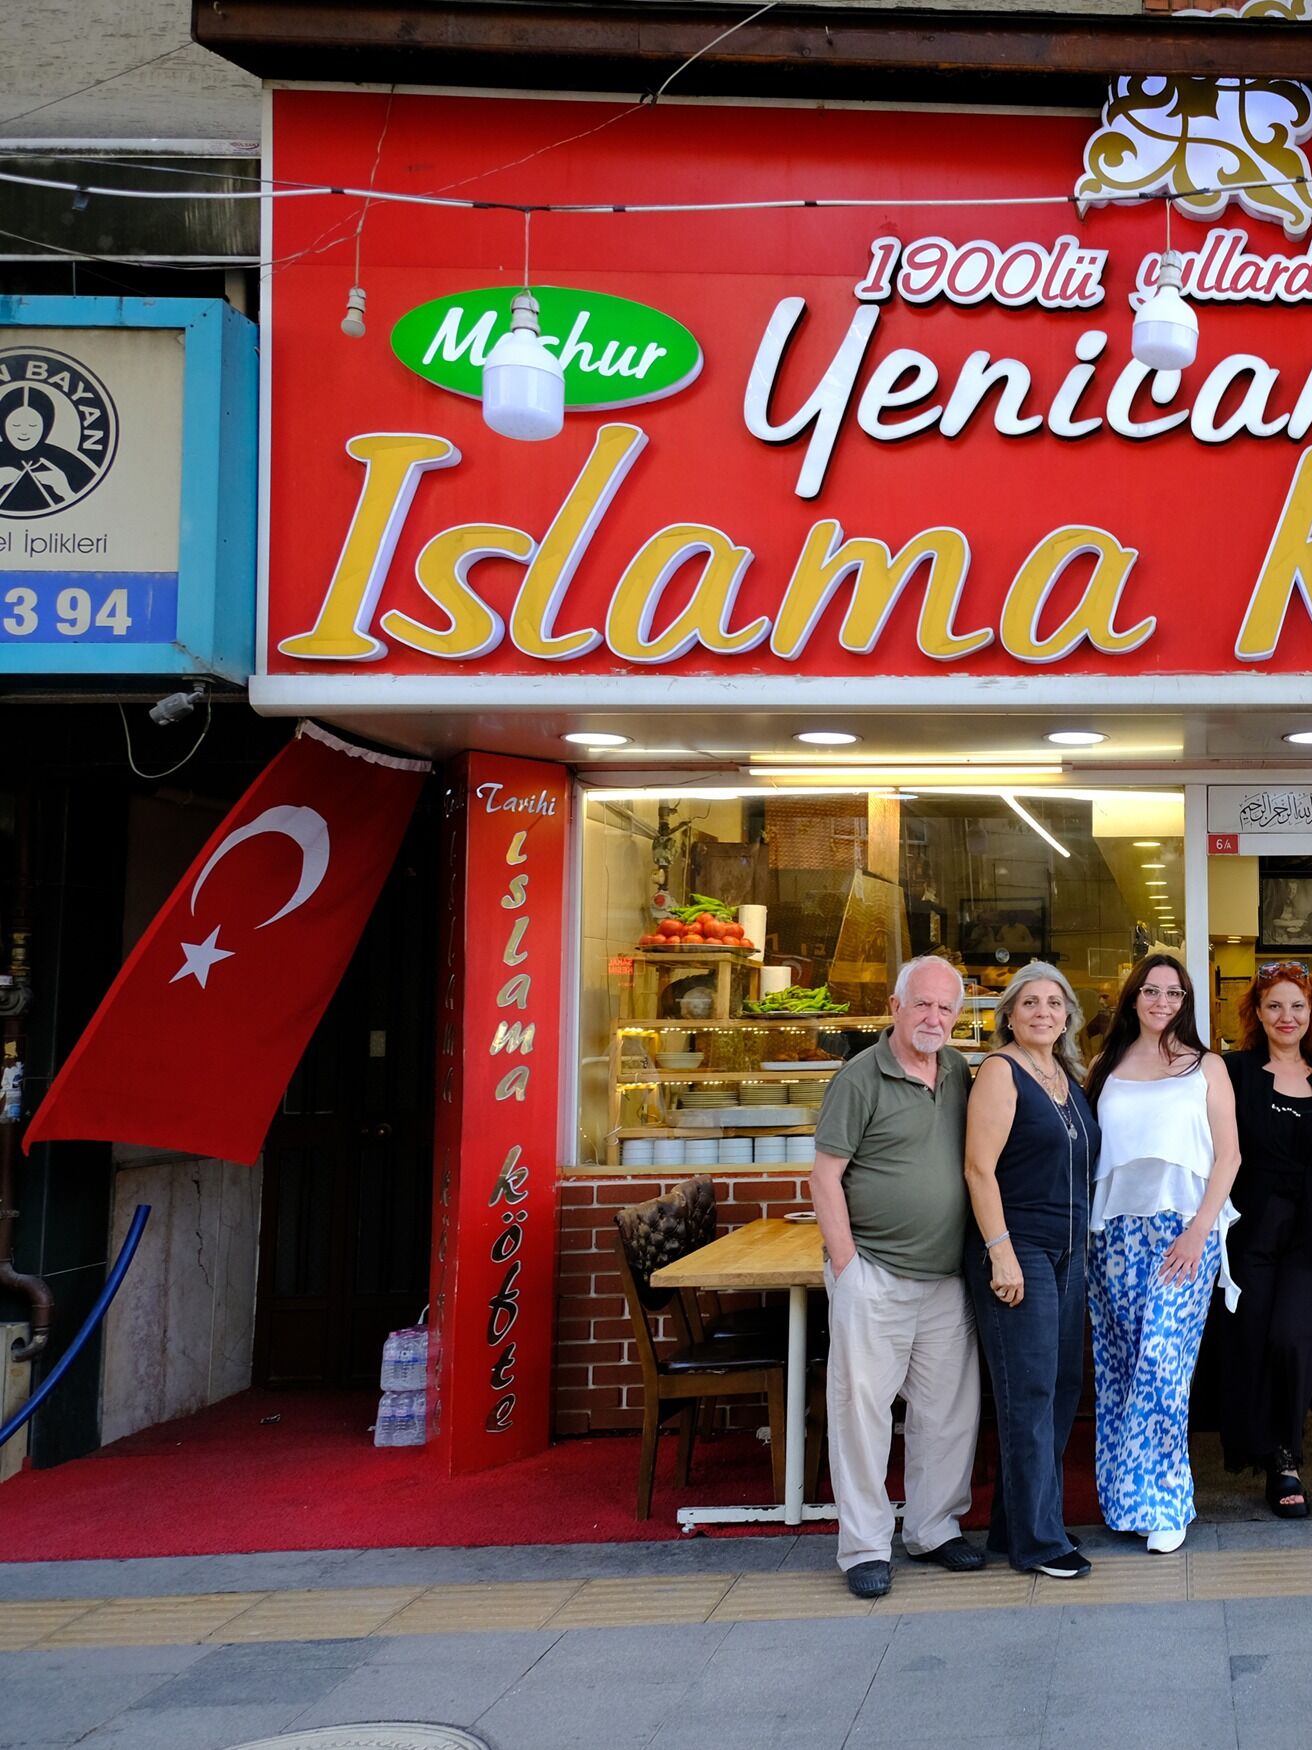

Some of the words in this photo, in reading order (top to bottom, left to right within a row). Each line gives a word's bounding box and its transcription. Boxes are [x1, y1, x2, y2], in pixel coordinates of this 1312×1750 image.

[861, 238, 1098, 302] 1900lü
[422, 306, 667, 379] Mhur
[25, 360, 104, 450] BAYAN
[25, 529, 108, 557] İplikleri
[277, 423, 1159, 664] Islama
[56, 588, 132, 637] 94
